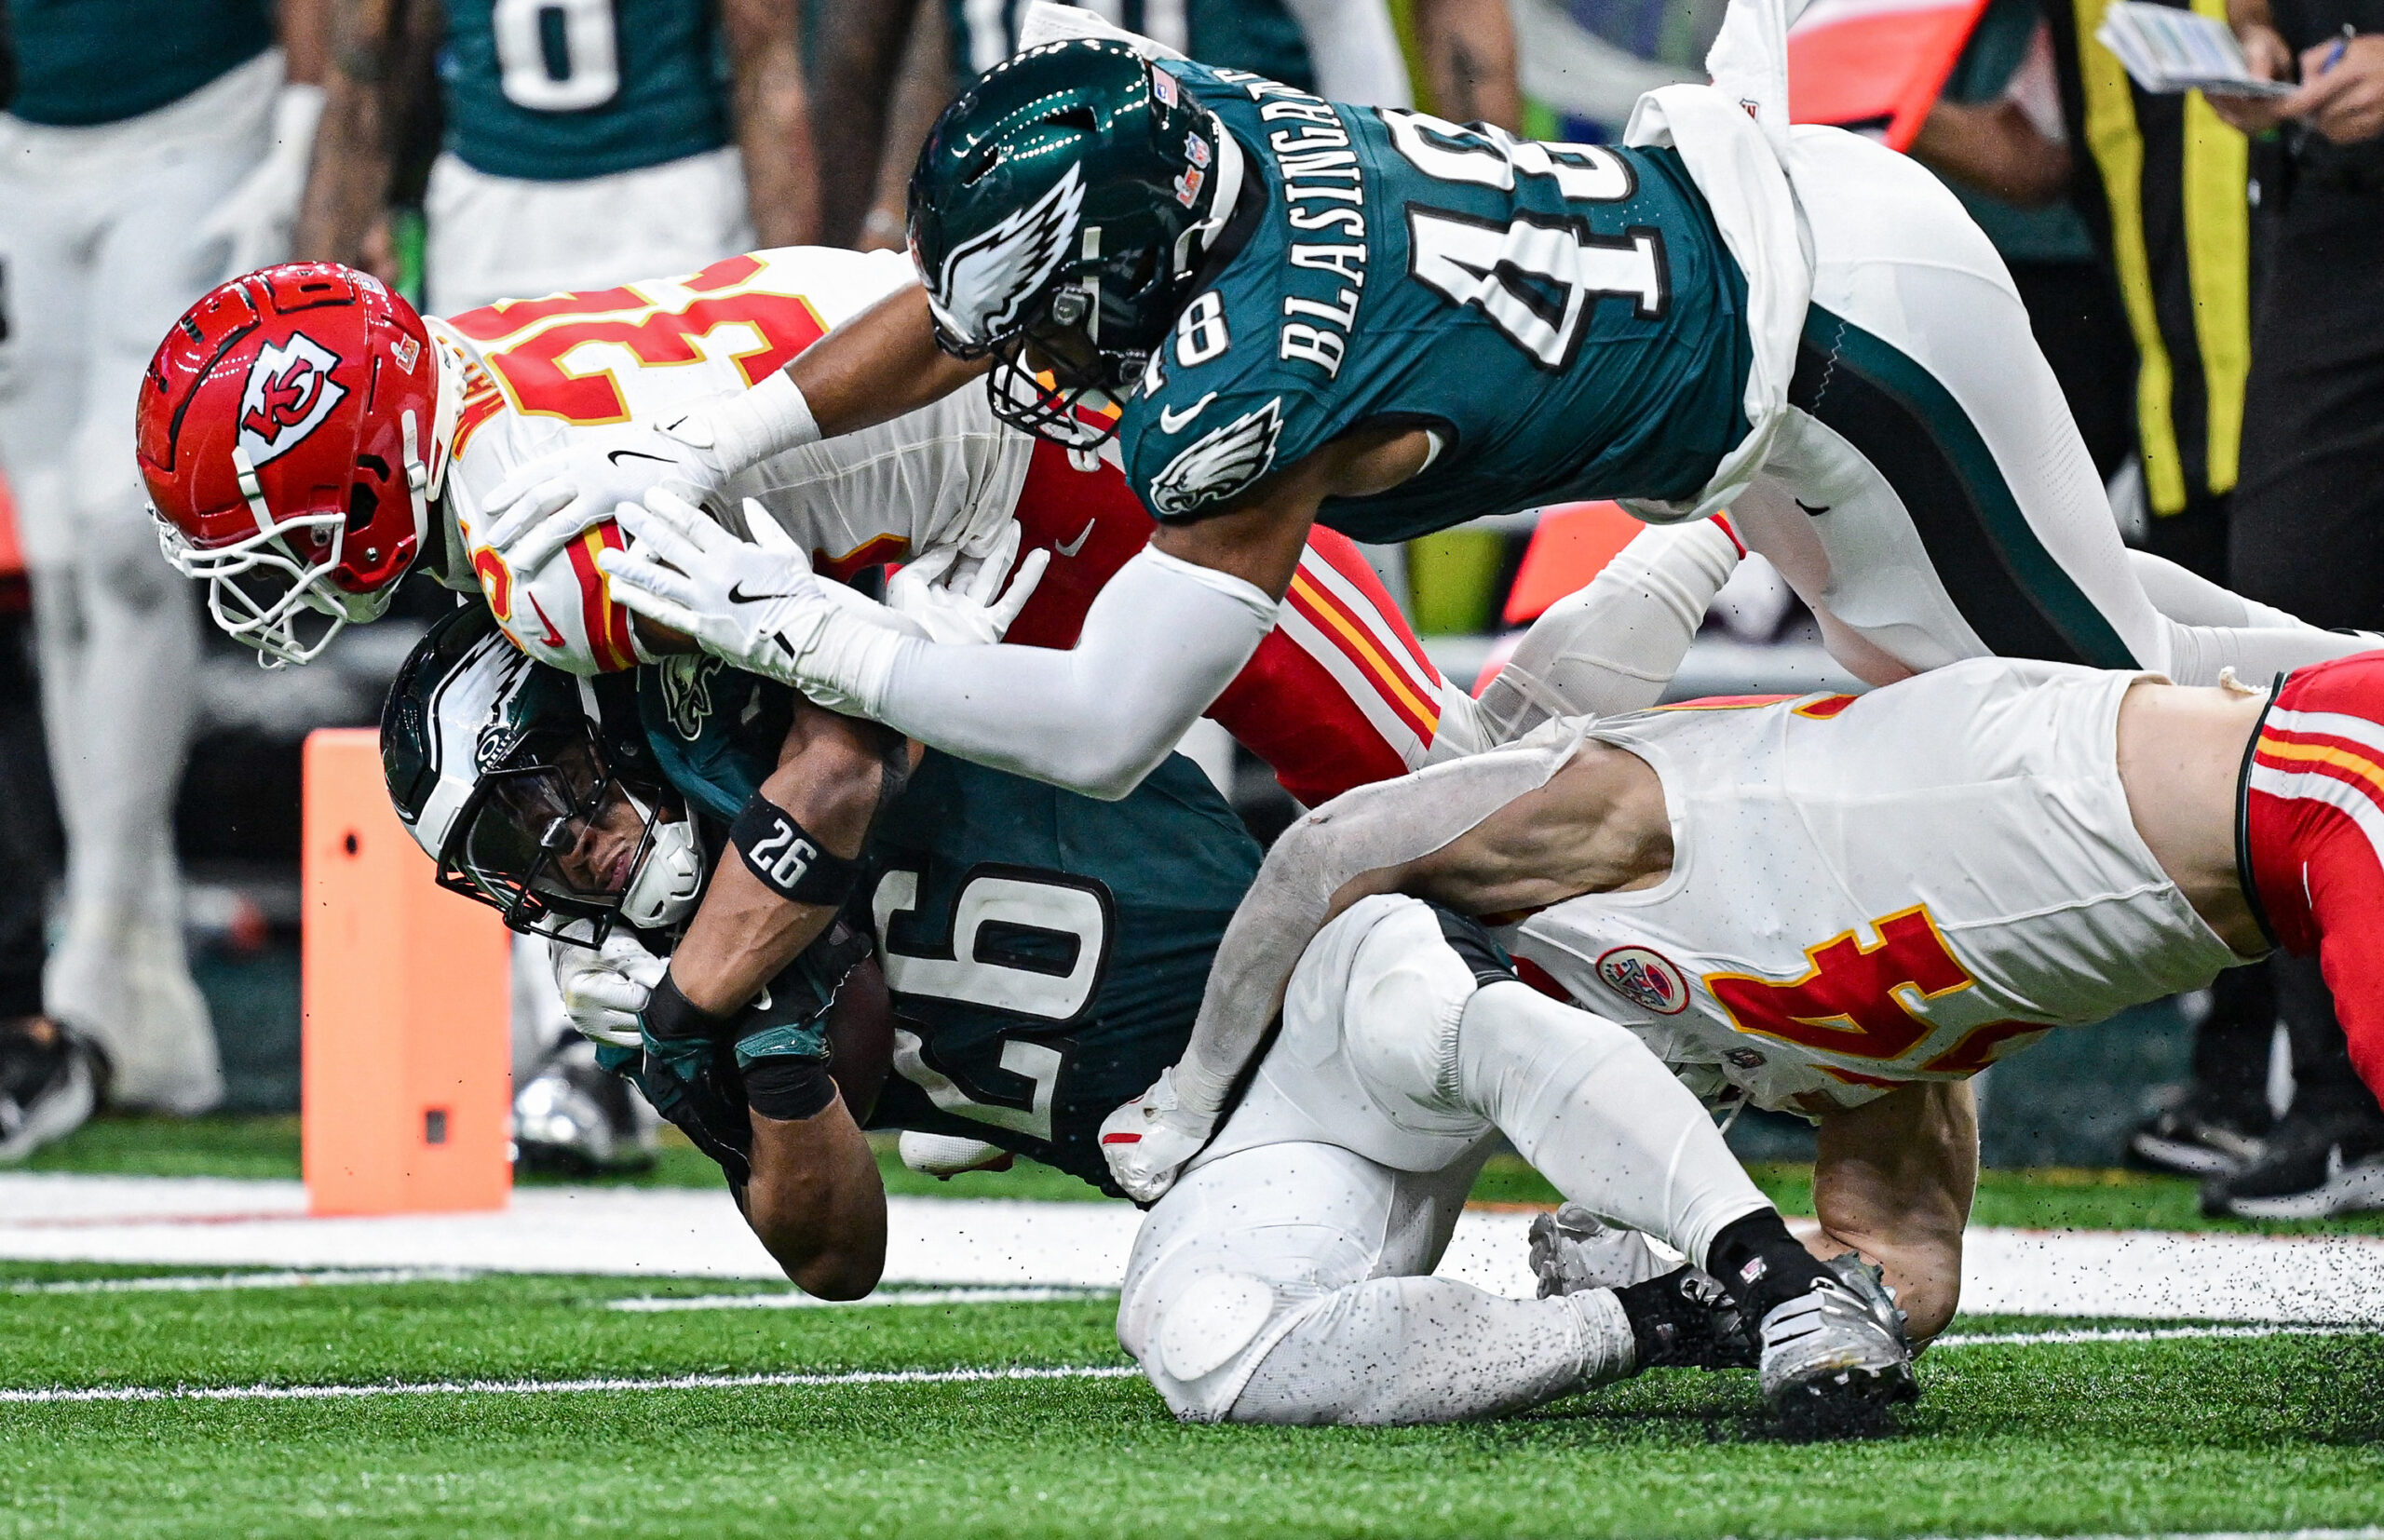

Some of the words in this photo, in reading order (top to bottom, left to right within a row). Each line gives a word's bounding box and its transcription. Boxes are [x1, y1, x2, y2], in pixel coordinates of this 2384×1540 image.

[1376, 106, 1668, 371] 48
[241, 356, 326, 447] KC
[481, 731, 515, 774] OAKLEY
[748, 817, 818, 888] 26
[871, 869, 1105, 1142] 26
